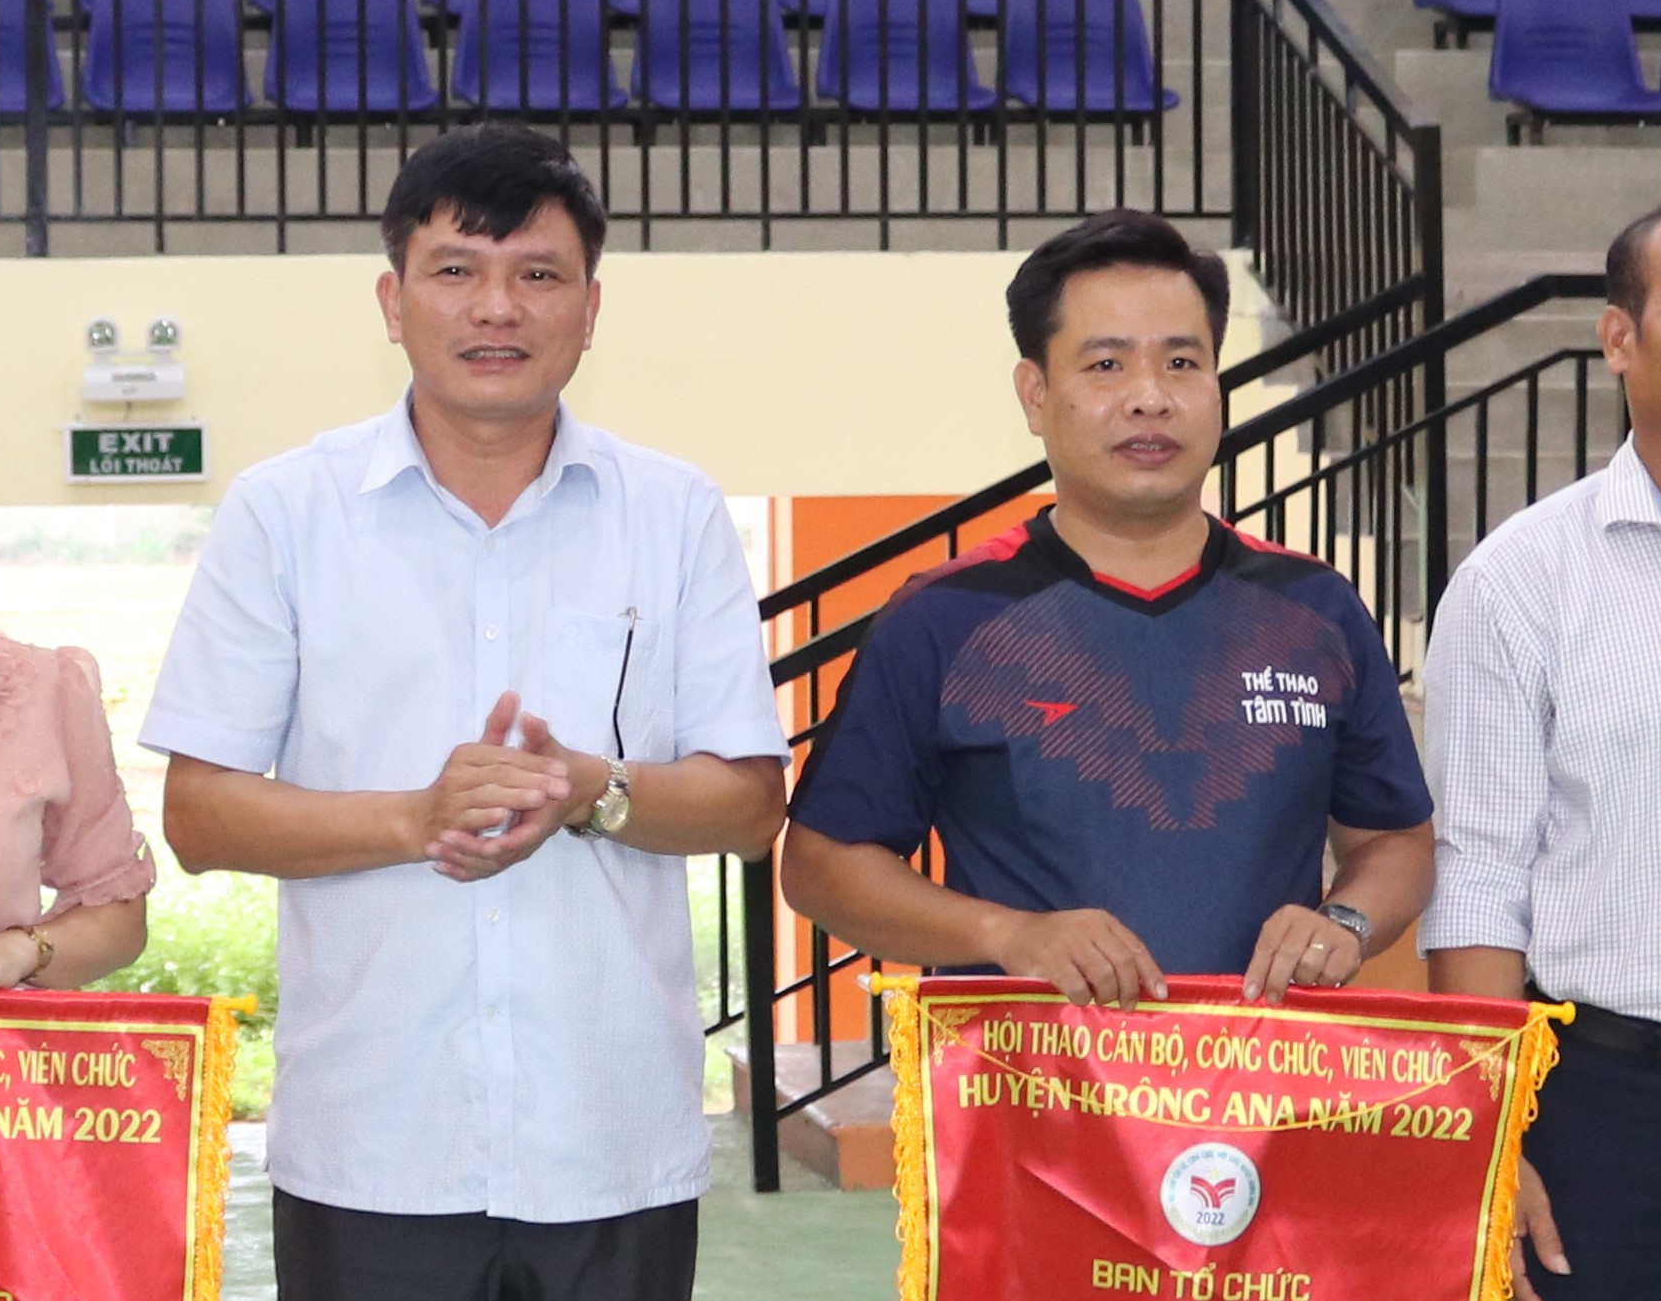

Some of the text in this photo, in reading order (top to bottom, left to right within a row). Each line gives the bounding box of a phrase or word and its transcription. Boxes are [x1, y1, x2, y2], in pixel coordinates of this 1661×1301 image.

[98, 432, 175, 453] EXIT
[125, 454, 183, 473] THOÁT
[1274, 672, 1319, 695] THAO
[17, 1047, 66, 1087] VIÊN
[71, 1042, 136, 1089] CHỨC
[983, 1013, 1453, 1086] HỘI THAO CÁN BỘ, CÔNG CHỨC, VIÊN CHỨC
[957, 1068, 1474, 1142] HUYỆN KRÔNG ANA NĂM 2022
[73, 1107, 162, 1144] 2022
[1196, 1211, 1225, 1225] 2022
[1092, 1258, 1159, 1296] BAN
[1170, 1262, 1217, 1301] TỔ
